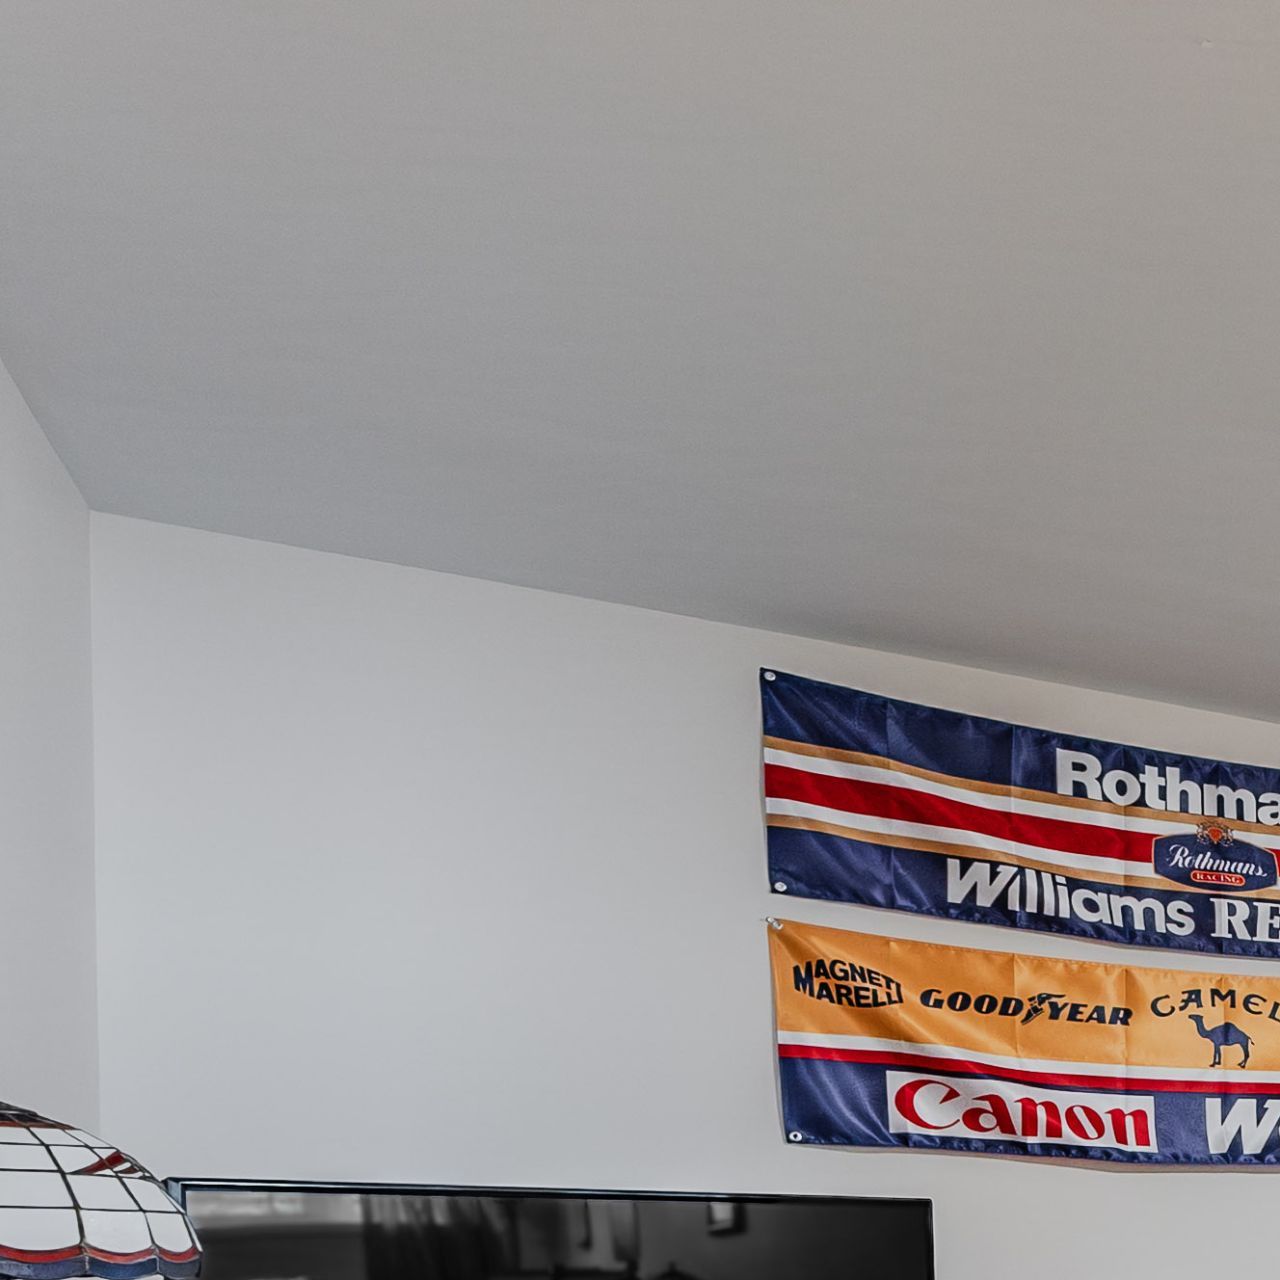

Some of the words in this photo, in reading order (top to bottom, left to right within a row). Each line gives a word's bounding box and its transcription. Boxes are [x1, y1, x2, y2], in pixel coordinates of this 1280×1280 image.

[1166, 844, 1268, 877] Rothmans
[1196, 871, 1241, 883] RACING
[946, 857, 1195, 936] Williams
[793, 959, 904, 999] MAGNETI
[894, 1079, 1152, 1147] Canon
